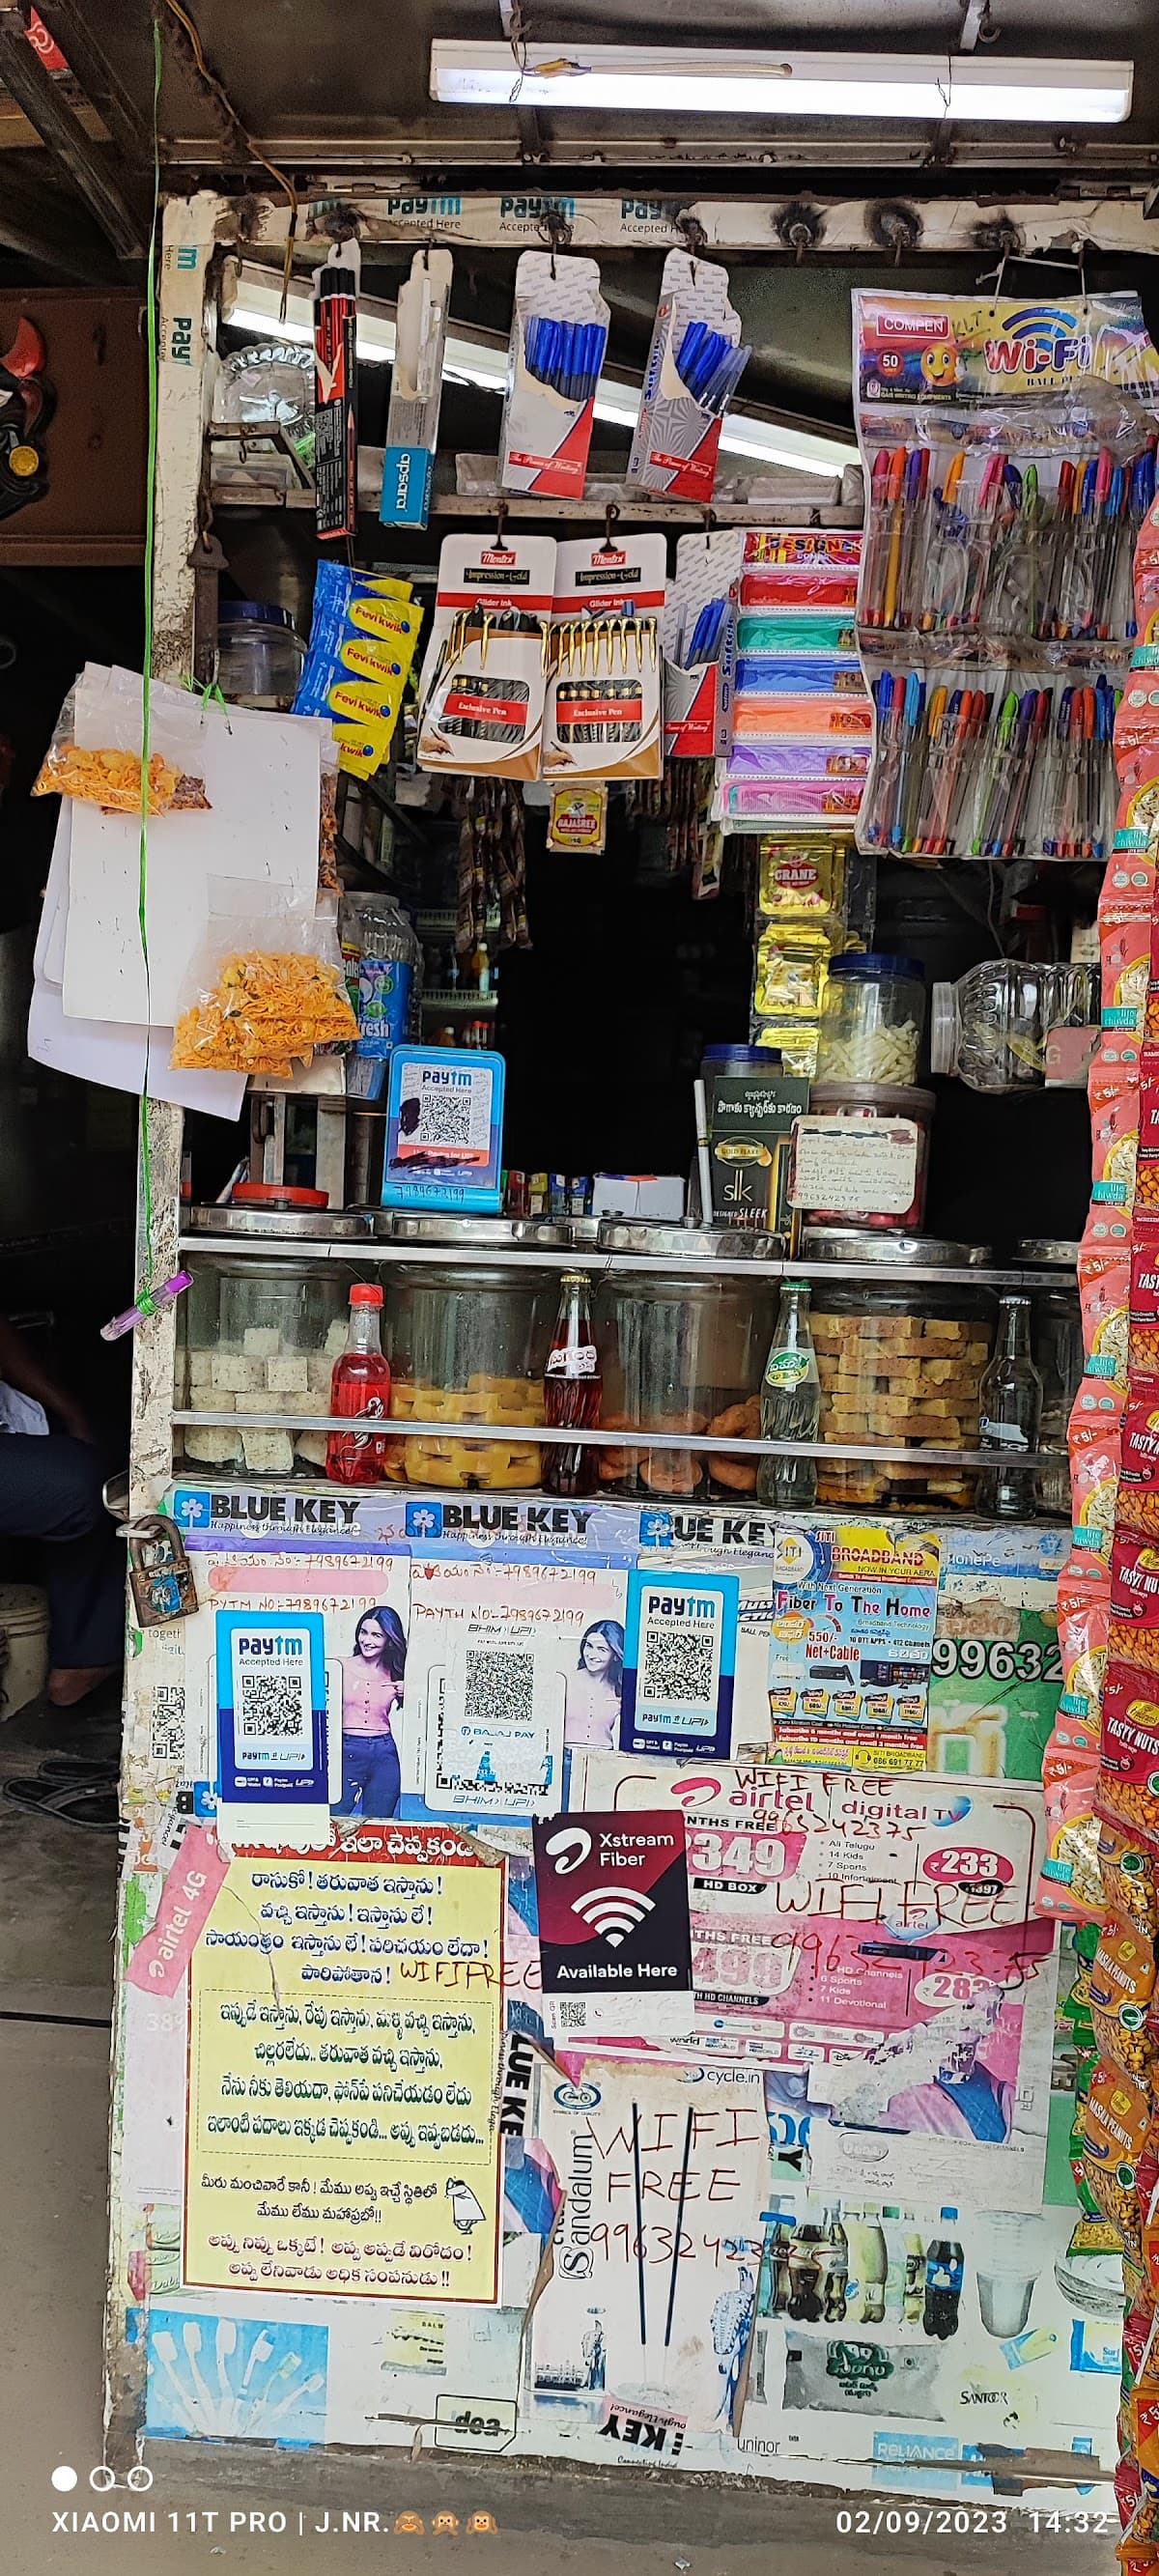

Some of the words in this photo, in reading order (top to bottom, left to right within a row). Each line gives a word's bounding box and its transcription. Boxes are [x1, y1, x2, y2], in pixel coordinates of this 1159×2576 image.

[436, 219, 462, 229] Here
[620, 223, 668, 233] Accepted
[884, 319, 945, 333] COMPEN
[882, 354, 898, 367] 50
[983, 334, 1092, 375] Wi-Fi
[395, 452, 411, 512] apsara
[774, 869, 818, 882] CRANE
[423, 1069, 472, 1087] paytm
[421, 1086, 454, 1094] Accepted
[740, 1206, 768, 1219] SLEEK
[211, 1495, 286, 1521] BLUE
[295, 1498, 361, 1524] KEY
[442, 1504, 519, 1530] BLUE
[527, 1507, 593, 1534] KEY
[832, 1546, 924, 1567] BROADBAND
[837, 1584, 883, 1594] Generation
[649, 1596, 716, 1618] paytm
[777, 1590, 818, 1611] Fiber
[825, 1594, 843, 1612] To
[851, 1596, 881, 1614] The
[886, 1598, 931, 1618] Home
[467, 1624, 502, 1634] BHIM
[647, 1617, 692, 1628] Accepted
[693, 1620, 716, 1629] Here
[808, 1631, 837, 1643] 550/-
[239, 1634, 302, 1656] paytm
[806, 1643, 861, 1661] Net+Cable
[239, 1657, 281, 1668] Accepted
[283, 1657, 303, 1667] Here
[642, 1713, 671, 1725] paytm
[514, 1730, 535, 1740] PAY
[1108, 1716, 1135, 1744] TASTY
[242, 1750, 269, 1761] paytm
[453, 1794, 495, 1806] BHIM
[729, 1787, 814, 1812] airtel
[841, 1799, 927, 1821] digital
[933, 1808, 963, 1821] TV
[735, 1820, 777, 1832] FREE
[599, 1833, 674, 1848] Xstream
[843, 1841, 875, 1852] Telugu
[600, 1852, 646, 1867] Fiber
[692, 1831, 785, 1877] 349
[836, 1862, 867, 1872] Sports
[317, 1872, 381, 1892] తరువాత
[703, 1880, 723, 1891] HD
[730, 1882, 758, 1893] BOX
[157, 1906, 192, 1961] airtel
[184, 1870, 209, 1902] 4G
[356, 1906, 408, 1930] ఇస్తాను
[291, 1933, 341, 1958] ఇస్తాను
[556, 1964, 634, 1980] Available
[637, 1965, 679, 1978] Here
[830, 1976, 863, 1987] Sports
[830, 1987, 852, 1996] Kids
[705, 1994, 717, 2002] HD
[718, 1995, 759, 2006] CHANNELS
[821, 1996, 832, 2004] 11
[834, 1996, 888, 2010] Devotional
[706, 2069, 760, 2086] cycle.in
[445, 2081, 472, 2106] లేదు
[608, 2168, 741, 2203] FREE
[558, 2131, 594, 2280] Sandalum
[738, 2436, 781, 2453] uninor
